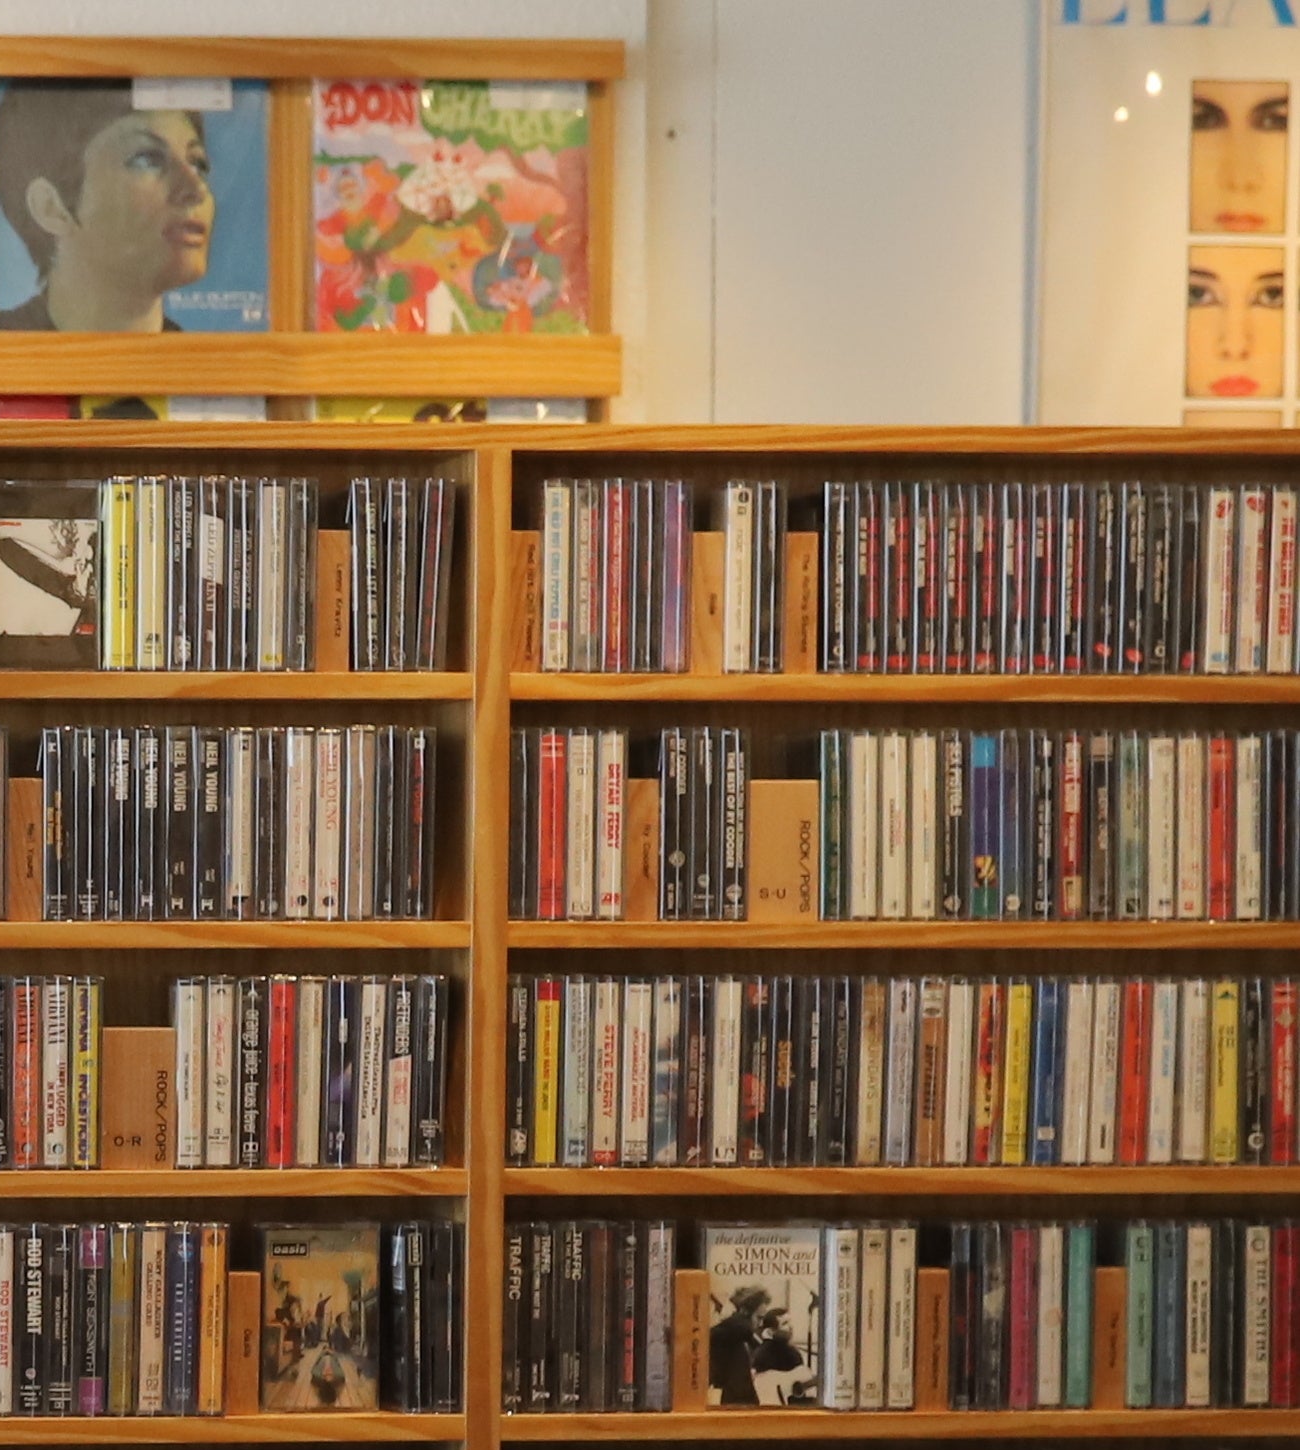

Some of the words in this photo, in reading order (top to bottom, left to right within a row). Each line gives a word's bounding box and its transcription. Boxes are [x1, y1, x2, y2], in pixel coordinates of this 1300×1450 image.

[322, 82, 418, 130] DON
[333, 564, 343, 593] Lenny
[333, 598, 343, 637] Kravitz
[206, 741, 218, 768] NEIL
[206, 772, 218, 812] YOUNG
[607, 764, 619, 805] BRYAN
[607, 811, 619, 849] FERRY
[800, 820, 811, 912] ROCK/POPS
[48, 990, 66, 1045] NIRVANA
[244, 1009, 259, 1047] orange
[396, 991, 410, 1055] PRETENDERS
[244, 1051, 259, 1074] juice
[603, 1025, 614, 1066] STEVE
[47, 1082, 55, 1090] IN
[47, 1093, 55, 1109] NEW
[56, 1062, 66, 1127] UNPLUGGED
[244, 1083, 259, 1107] texas
[603, 1071, 614, 1118] PERRY
[47, 1112, 55, 1134] YORK
[155, 1070, 167, 1161] ROCK/POPS
[244, 1109, 259, 1134] fever
[115, 1136, 141, 1147] O-R
[27, 1238, 42, 1266] ROD
[273, 1245, 306, 1255] oasis
[715, 1235, 732, 1246] the
[735, 1235, 791, 1246] definitive
[735, 1249, 790, 1260] SIMON
[793, 1249, 816, 1260] and
[509, 1237, 521, 1300] TRAFFIC
[714, 1262, 816, 1275] GARFUNKEL
[27, 1270, 42, 1334] STEWART
